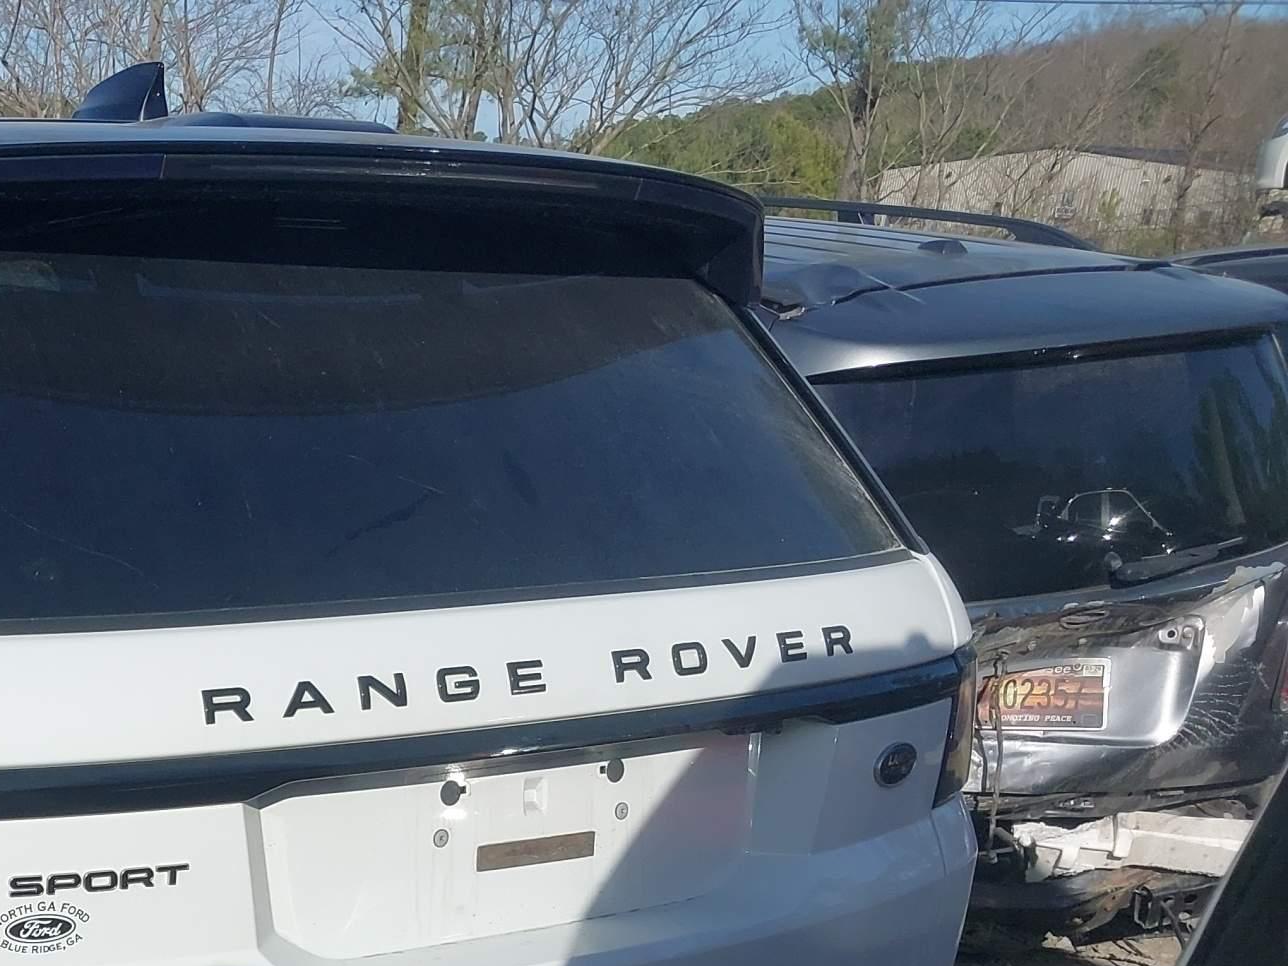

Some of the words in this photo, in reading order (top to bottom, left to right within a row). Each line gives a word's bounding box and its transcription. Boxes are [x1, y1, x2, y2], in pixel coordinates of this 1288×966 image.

[201, 659, 547, 724] RANGE
[611, 625, 854, 684] ROVER
[1045, 713, 1072, 722] PEACE
[9, 863, 190, 897] SPORT
[37, 901, 56, 912] GA
[60, 902, 90, 923] FORD
[20, 919, 63, 939] Ford
[0, 940, 28, 954] BLUE
[31, 942, 66, 954] RIDGE,
[66, 933, 83, 946] GA
